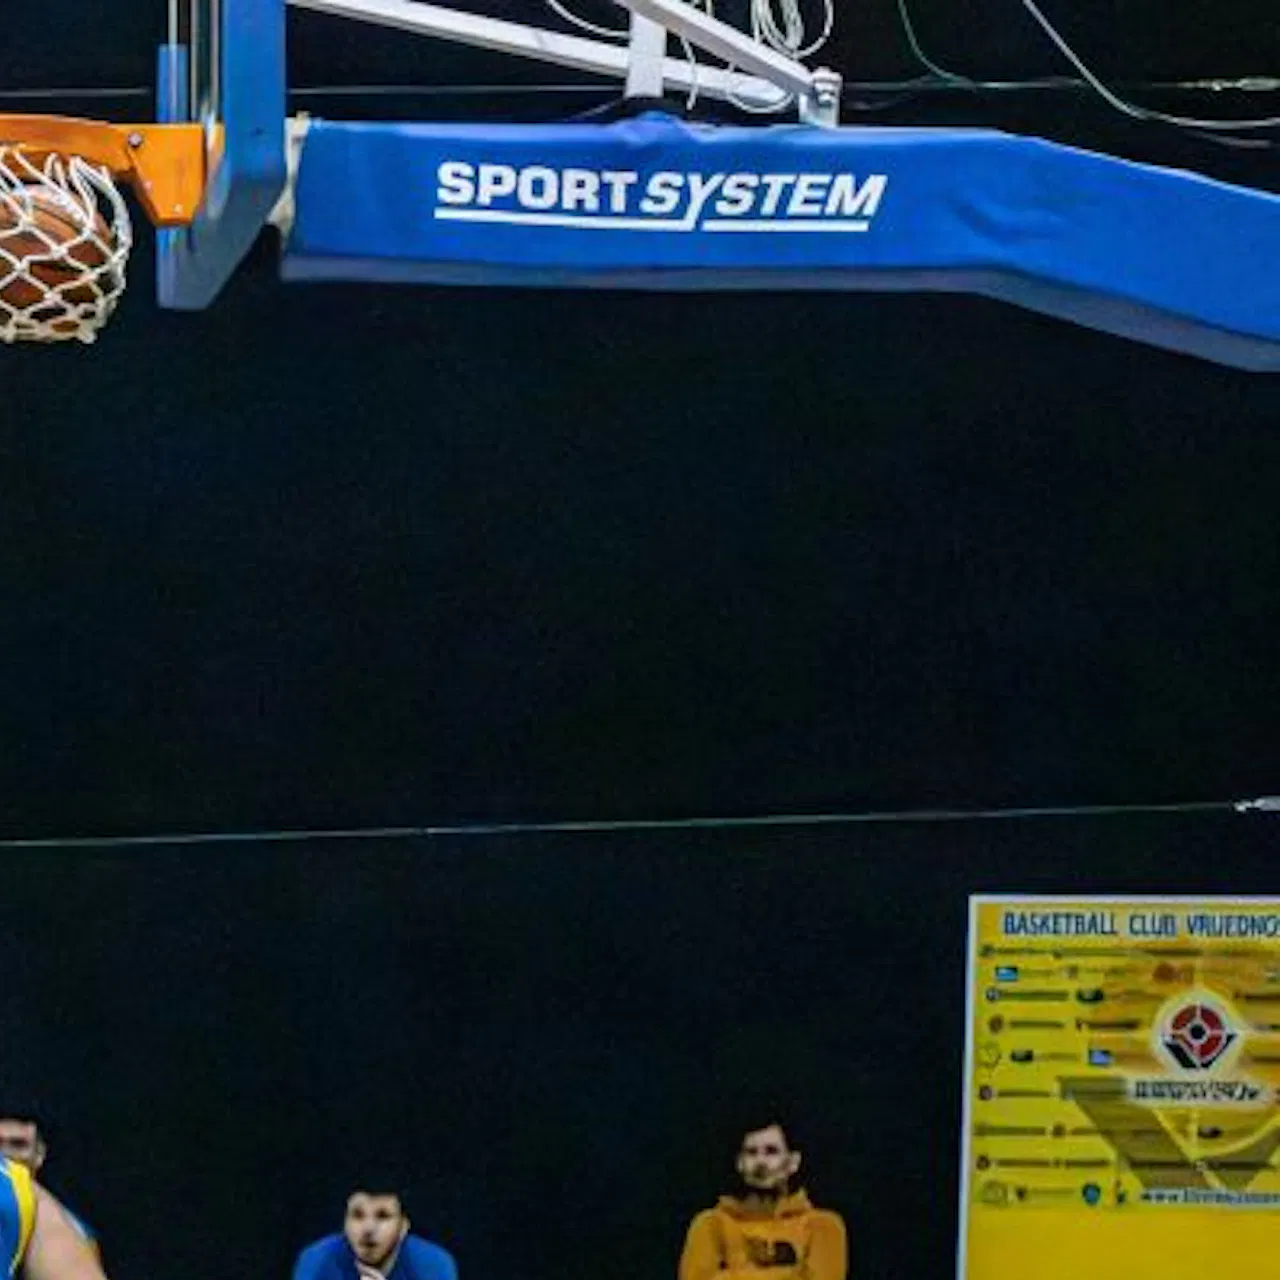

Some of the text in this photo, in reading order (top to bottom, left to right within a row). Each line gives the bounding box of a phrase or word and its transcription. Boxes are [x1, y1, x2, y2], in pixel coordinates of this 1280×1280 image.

[436, 161, 888, 231] SPORT SYSTEM
[1004, 912, 1117, 936] BASKETBALL
[1129, 914, 1177, 937] CLUB
